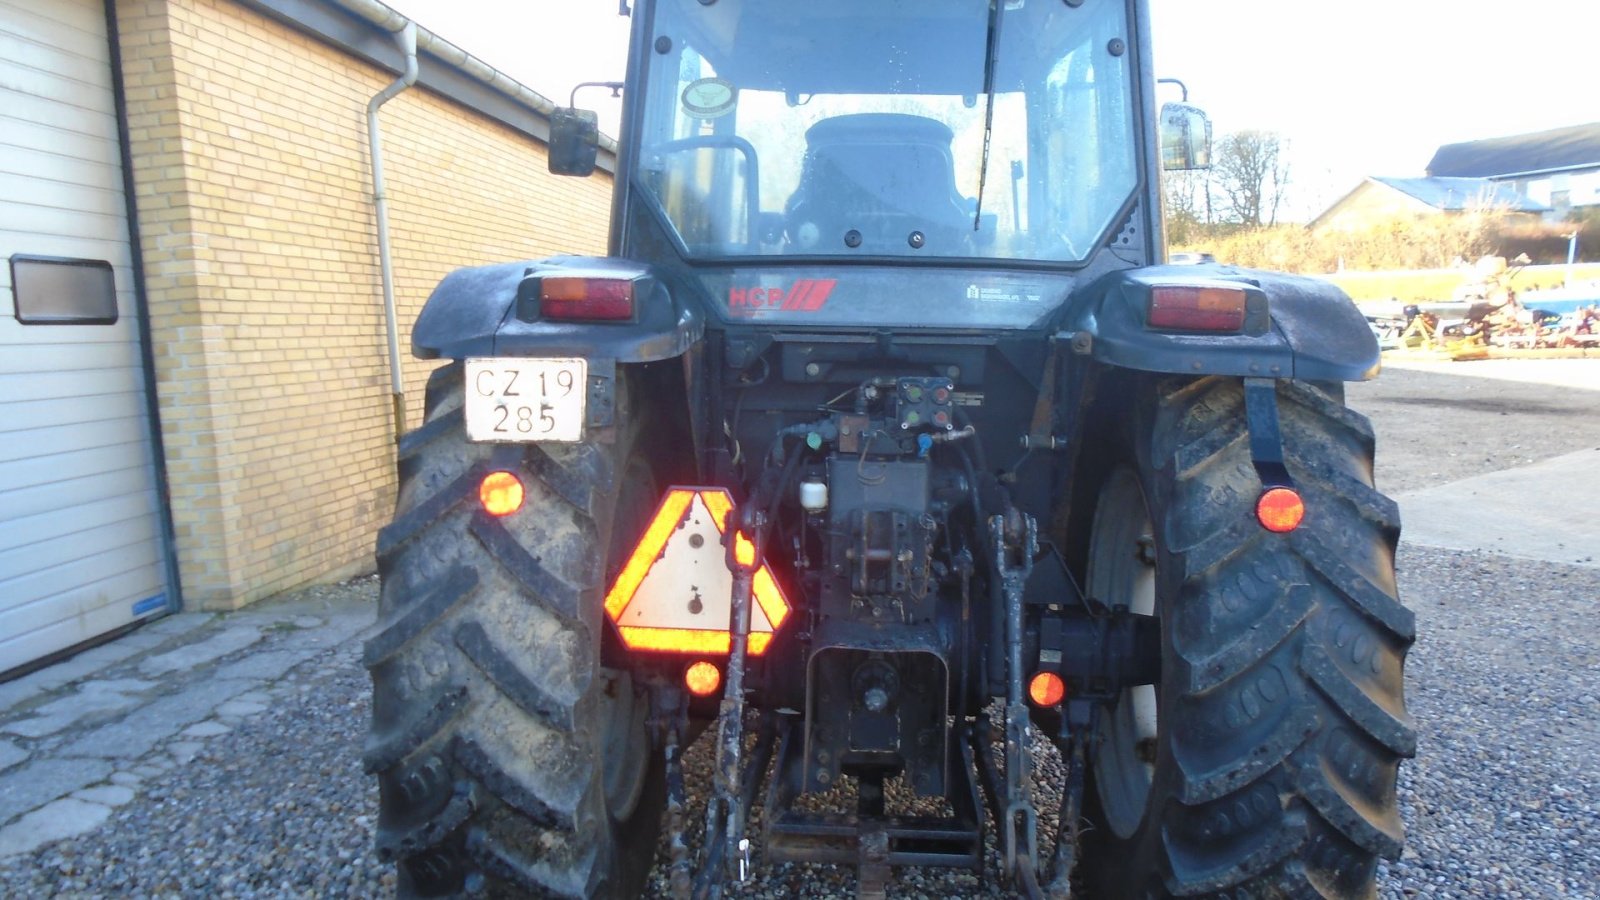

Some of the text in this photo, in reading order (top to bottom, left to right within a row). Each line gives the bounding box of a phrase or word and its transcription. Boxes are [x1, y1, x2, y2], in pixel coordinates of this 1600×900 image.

[729, 287, 785, 308] HCP
[476, 369, 573, 397] CZ 19
[493, 404, 555, 433] 285
